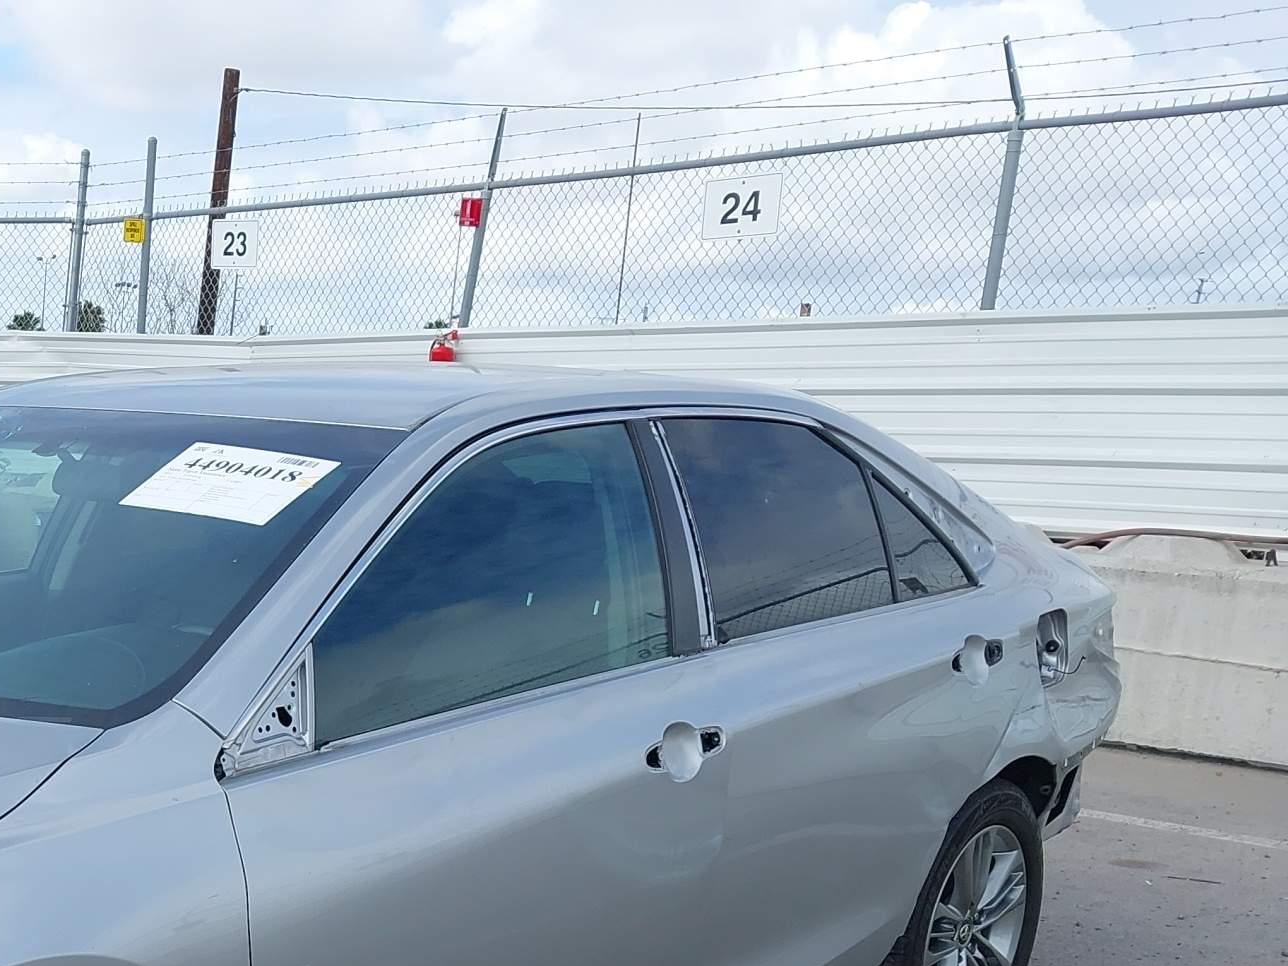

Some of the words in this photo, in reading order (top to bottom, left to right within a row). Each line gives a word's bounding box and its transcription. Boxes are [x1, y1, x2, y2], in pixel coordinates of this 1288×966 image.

[721, 191, 760, 224] 24
[224, 232, 247, 256] 23
[185, 457, 303, 482] 44904018
